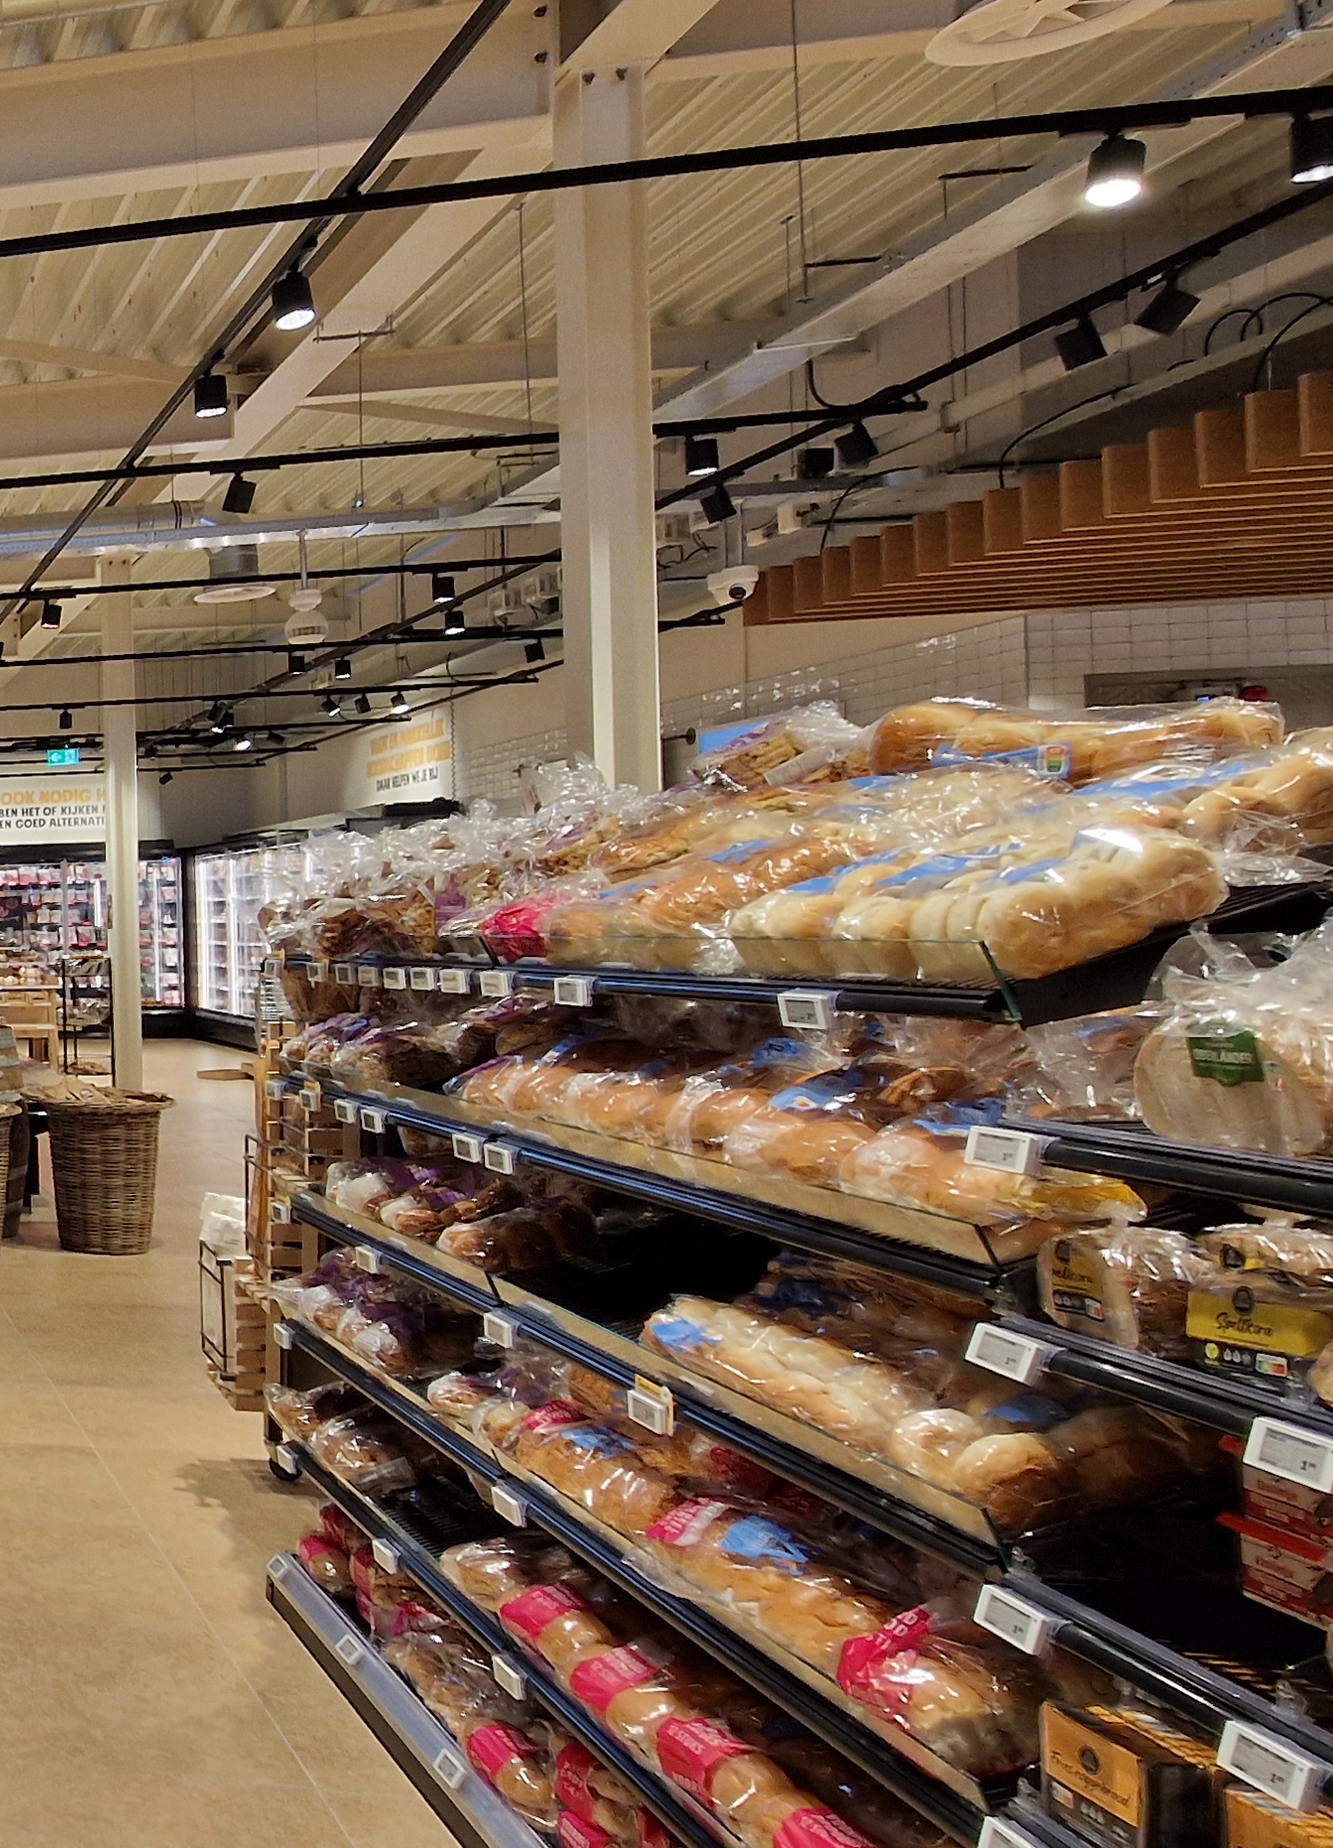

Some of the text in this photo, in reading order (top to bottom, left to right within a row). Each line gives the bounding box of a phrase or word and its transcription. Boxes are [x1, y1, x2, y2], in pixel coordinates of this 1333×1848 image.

[1, 791, 35, 805] OOK
[39, 789, 91, 804] NODIG
[21, 807, 40, 817] HET
[42, 806, 57, 816] OF
[61, 805, 99, 816] KIJKEN
[15, 818, 46, 829] GOED
[49, 817, 105, 828] ALTERNATI
